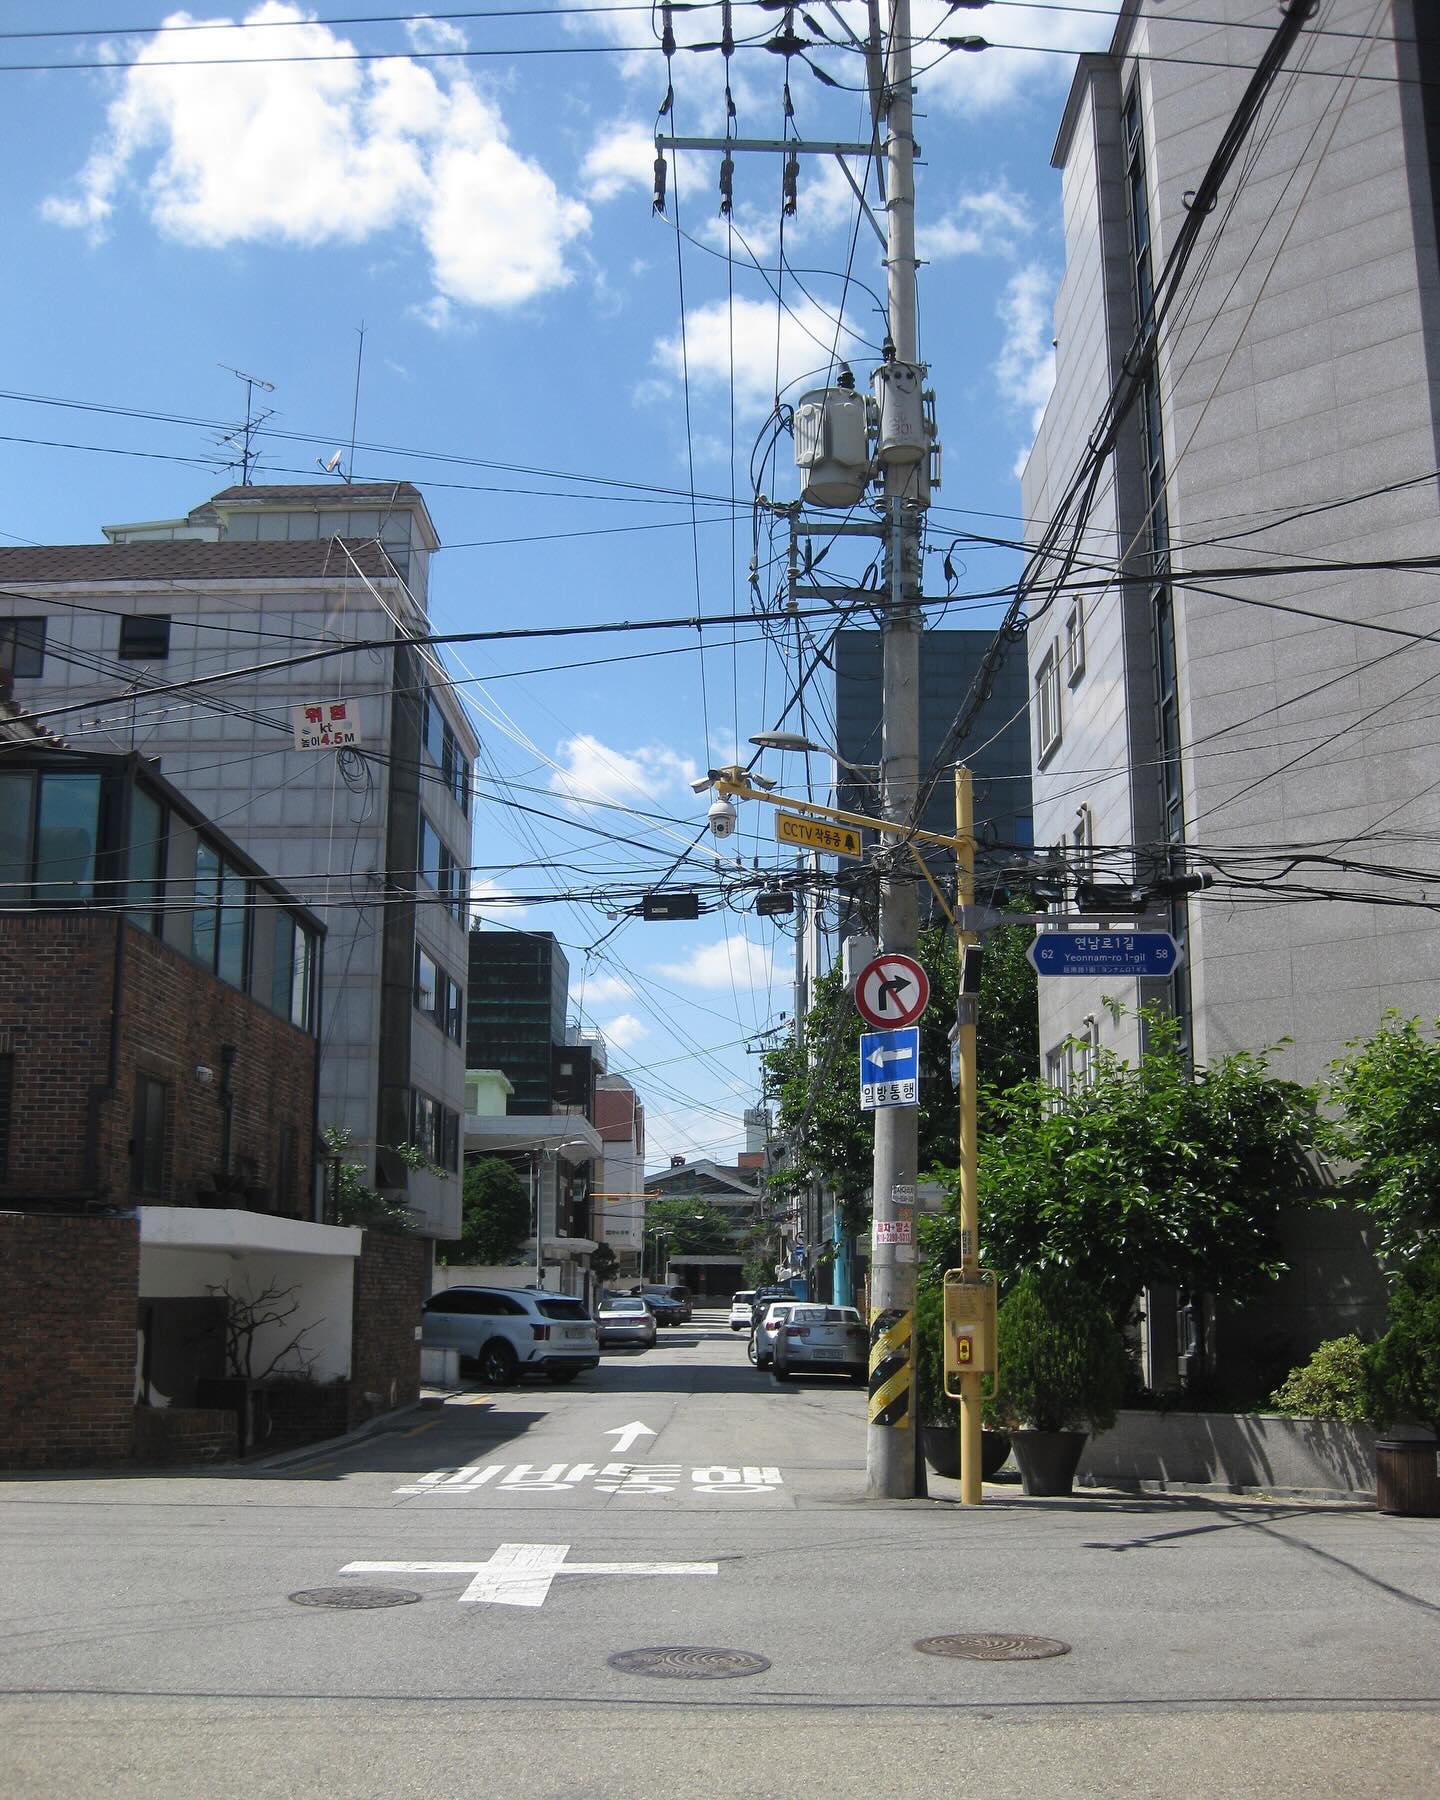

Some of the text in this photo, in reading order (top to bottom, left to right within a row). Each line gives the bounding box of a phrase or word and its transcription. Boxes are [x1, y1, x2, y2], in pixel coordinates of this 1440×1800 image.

[320, 723, 333, 734] kt
[783, 821, 842, 847] CCTV 작동중
[1074, 936, 1135, 950] 연남로1길
[1041, 949, 1054, 959] 62
[1064, 953, 1146, 963] Yeonnam-ro 1-gil
[1156, 949, 1168, 959] 58
[864, 1082, 914, 1103] 일방통행
